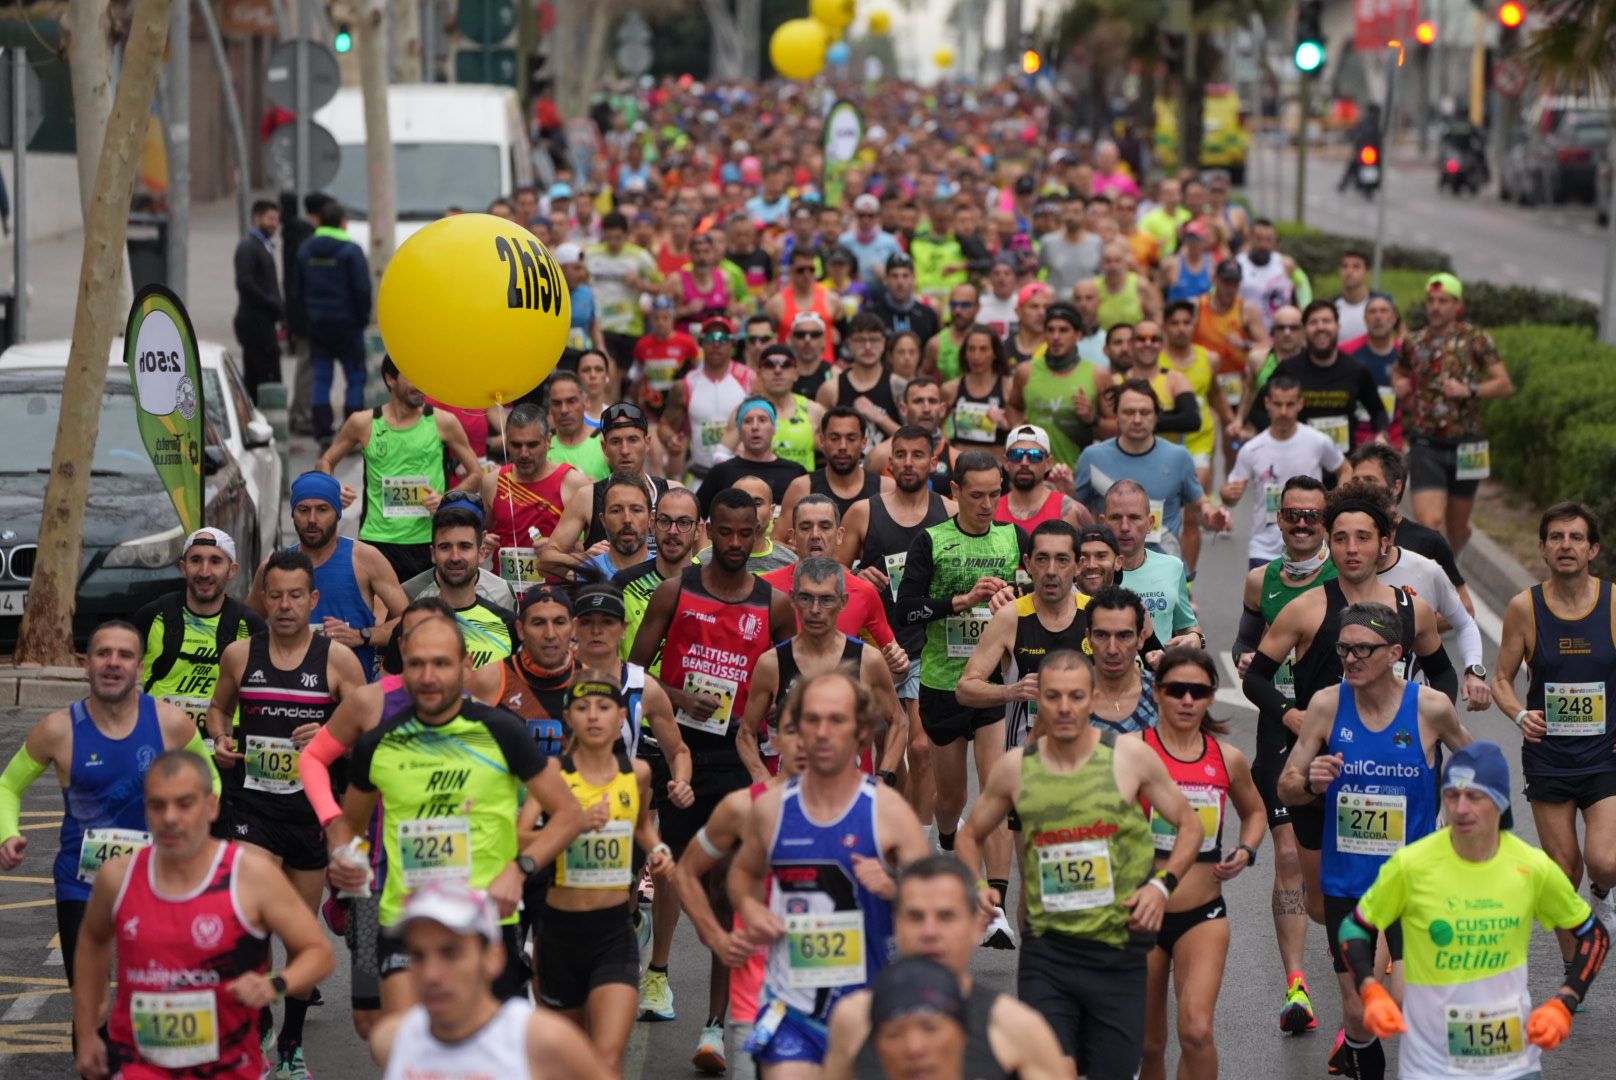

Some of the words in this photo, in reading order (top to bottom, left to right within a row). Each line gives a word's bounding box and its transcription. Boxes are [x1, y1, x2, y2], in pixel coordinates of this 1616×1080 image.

[495, 236, 562, 317] 2h50
[392, 487, 418, 501] 231
[687, 643, 748, 667] ATLETISMO
[192, 665, 213, 675] FOR
[175, 675, 217, 695] LIFE
[1557, 697, 1593, 715] 248
[257, 751, 293, 773] 103
[1338, 760, 1420, 778] ailCantos
[425, 768, 472, 793] RUN
[1350, 809, 1389, 831] 271
[1352, 831, 1388, 840] ALCOBA
[413, 836, 454, 860] 224
[581, 838, 620, 862] 160
[1054, 860, 1096, 884] 152
[1455, 916, 1520, 932] CUSTOM
[800, 931, 847, 959] 632
[1455, 934, 1499, 947] TEAK
[1434, 950, 1511, 971] Cetilar
[152, 1013, 197, 1039] 120
[1464, 1021, 1509, 1047] 154
